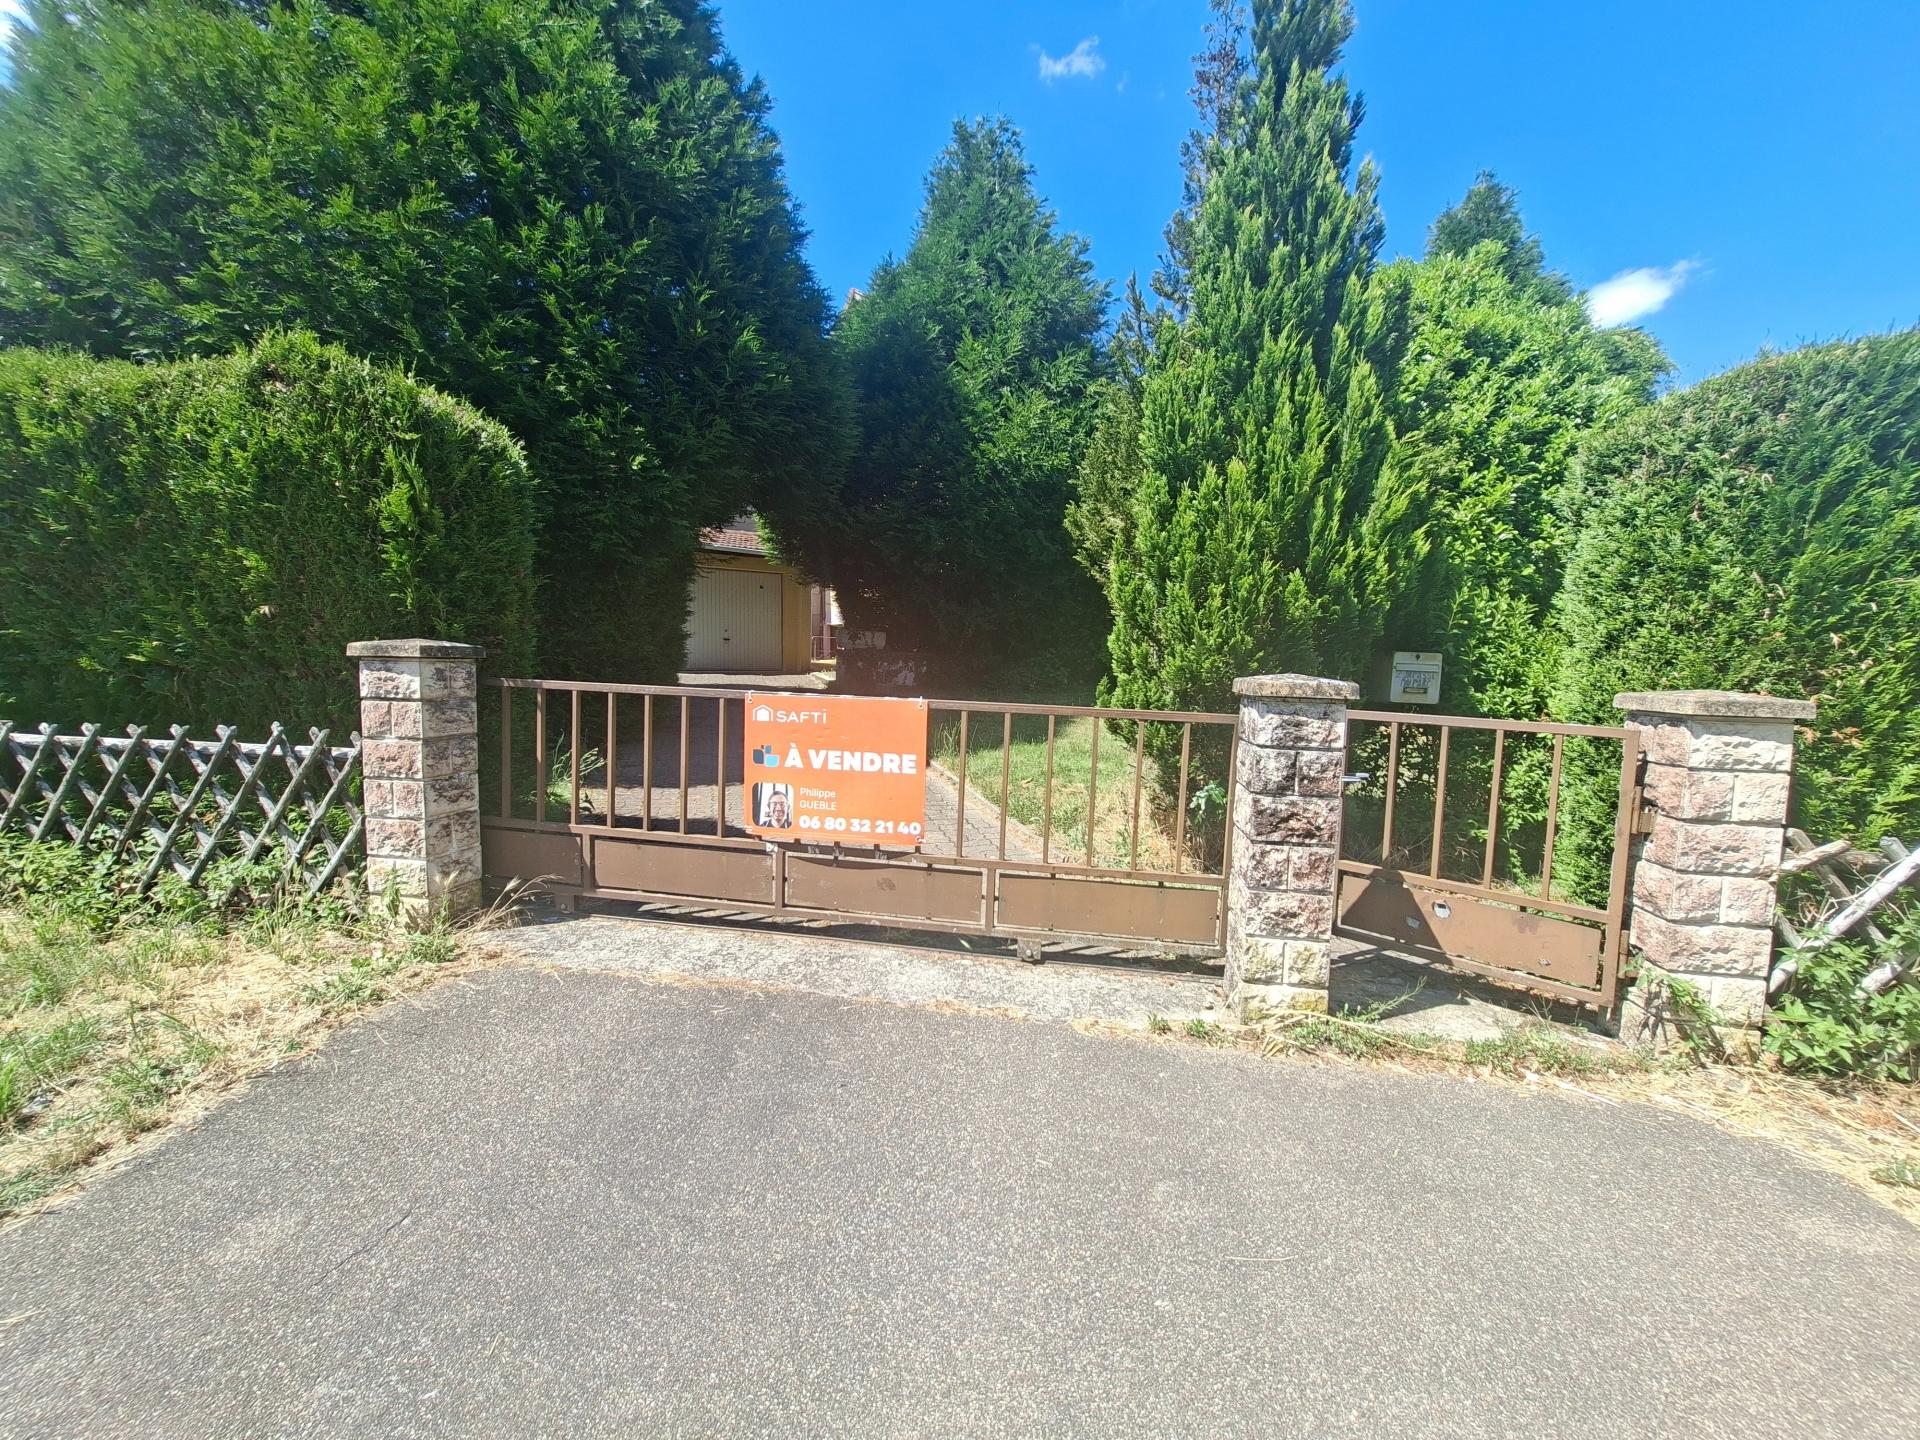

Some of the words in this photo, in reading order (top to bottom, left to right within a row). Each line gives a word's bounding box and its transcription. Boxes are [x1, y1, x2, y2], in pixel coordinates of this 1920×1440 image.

[784, 742, 804, 768] À
[808, 749, 917, 774] VENDRE
[800, 787, 836, 799] Philippe
[799, 815, 821, 830] 06
[824, 817, 847, 831] 80
[850, 819, 871, 833] 32
[875, 820, 894, 833] 21
[897, 821, 921, 835] 40
